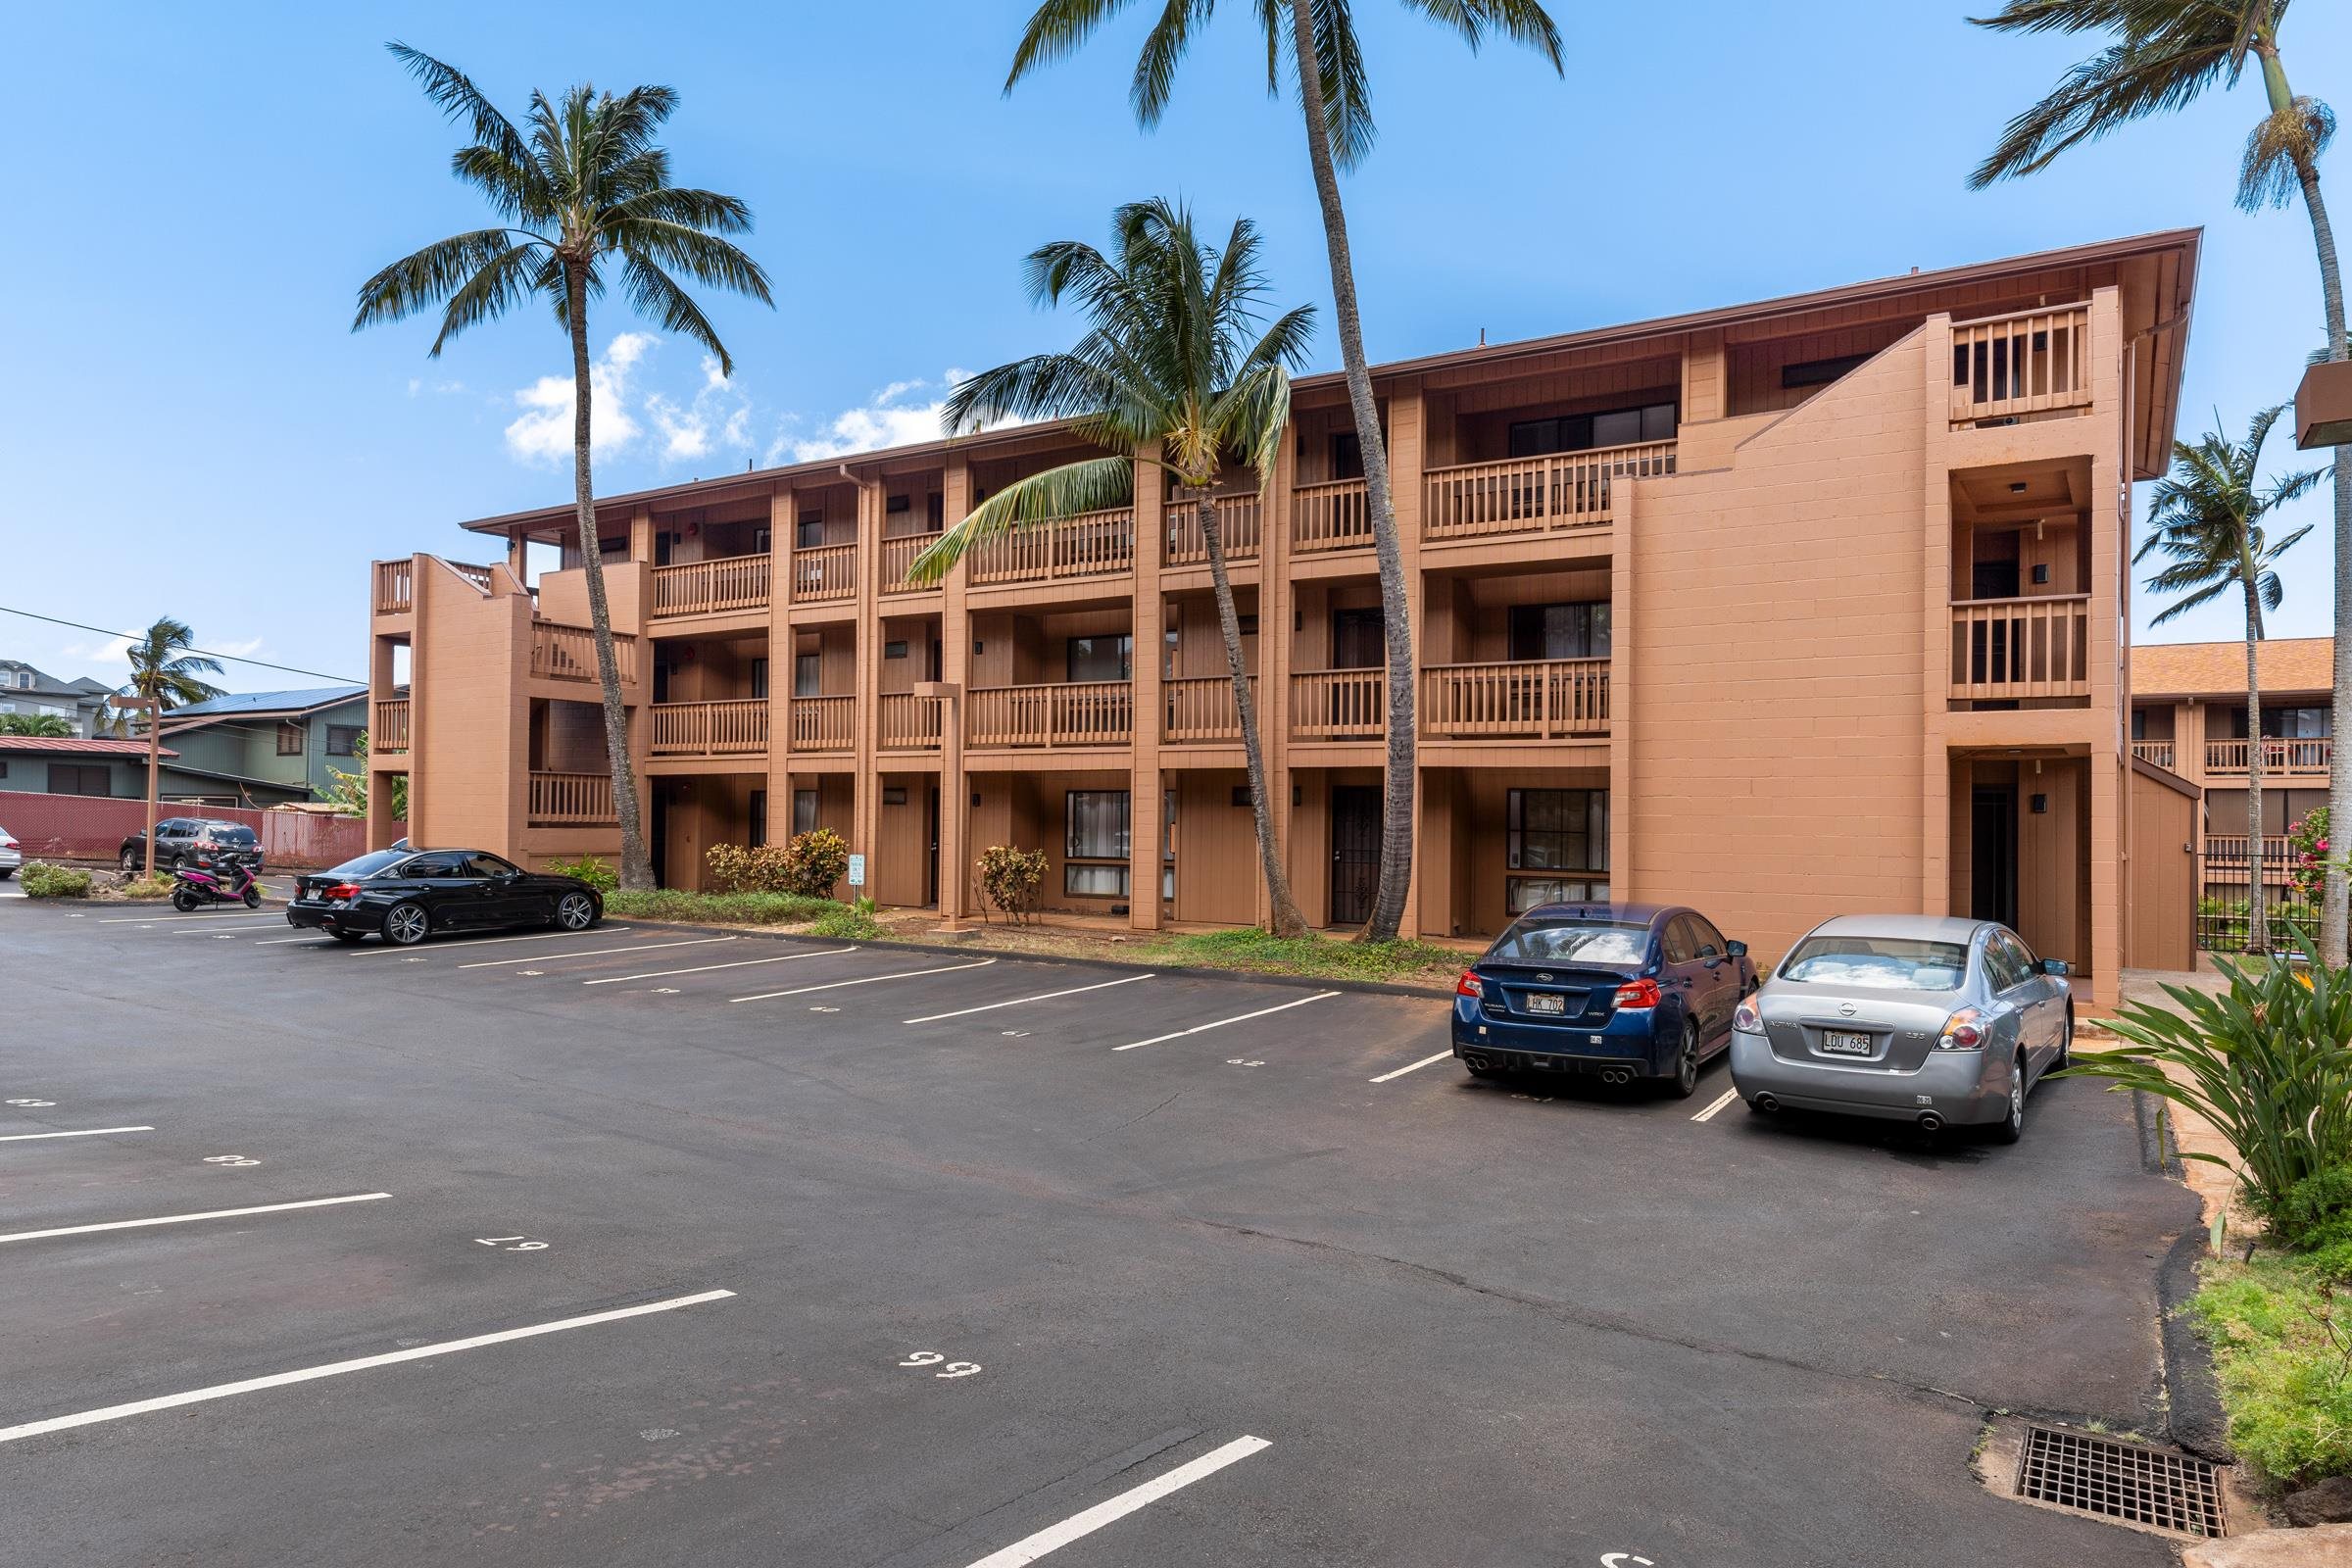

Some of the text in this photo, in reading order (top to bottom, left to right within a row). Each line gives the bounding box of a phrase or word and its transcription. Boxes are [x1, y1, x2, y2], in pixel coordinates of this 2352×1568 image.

[1548, 999, 1563, 1010] 702
[1824, 1034, 1869, 1051] LDU 685
[1226, 1058, 1266, 1067] 62
